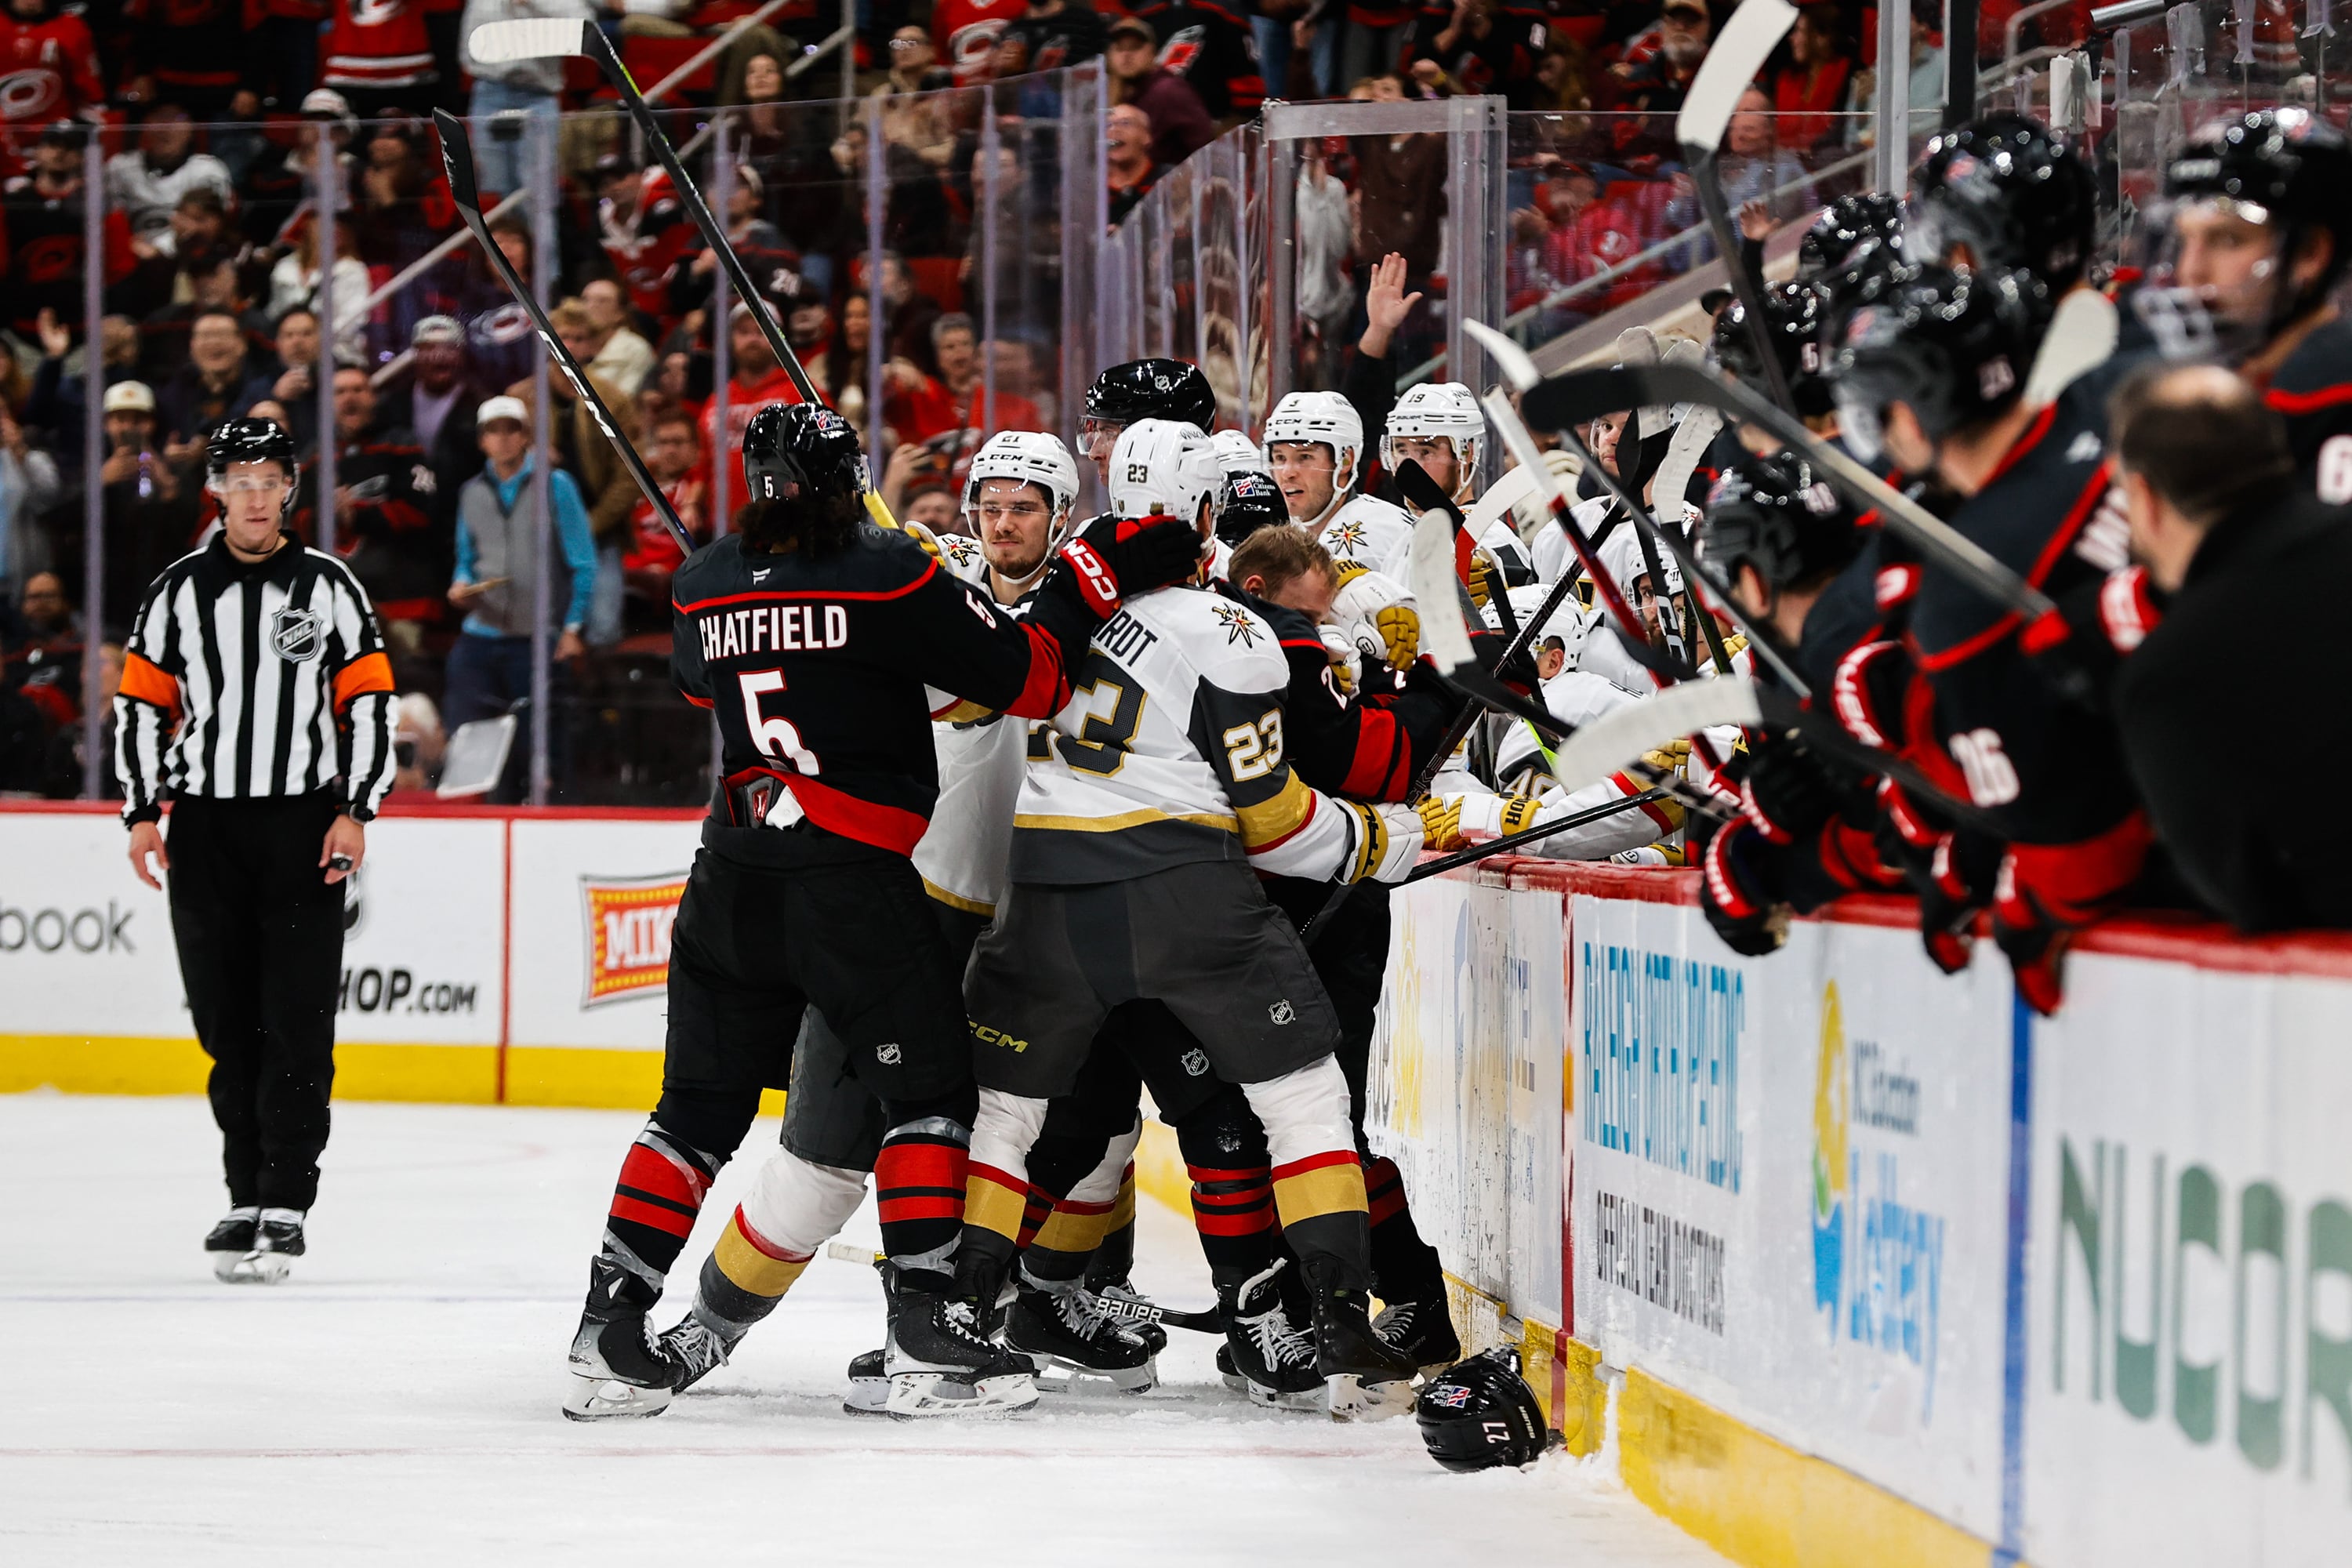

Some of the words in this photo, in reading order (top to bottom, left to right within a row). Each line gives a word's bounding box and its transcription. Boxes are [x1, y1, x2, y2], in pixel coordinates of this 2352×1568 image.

[1407, 393, 1426, 404] 19
[989, 453, 1024, 462] CCM
[1127, 463, 1149, 484] 23
[764, 475, 774, 499] 5
[698, 604, 848, 662] CHATFIELD
[965, 588, 997, 630] 5
[1091, 608, 1159, 667] RDT
[736, 666, 822, 777] 5
[1222, 707, 1285, 783] 23
[0, 898, 136, 954] book
[1584, 940, 1641, 1158] RALEIGH
[1646, 950, 1746, 1196] ORTHOPAEDIC
[1643, 1207, 1671, 1310] TEAM
[1096, 1298, 1163, 1323] BAUER
[2052, 1131, 2352, 1513] NUCOR
[1481, 1421, 1511, 1445] 27
